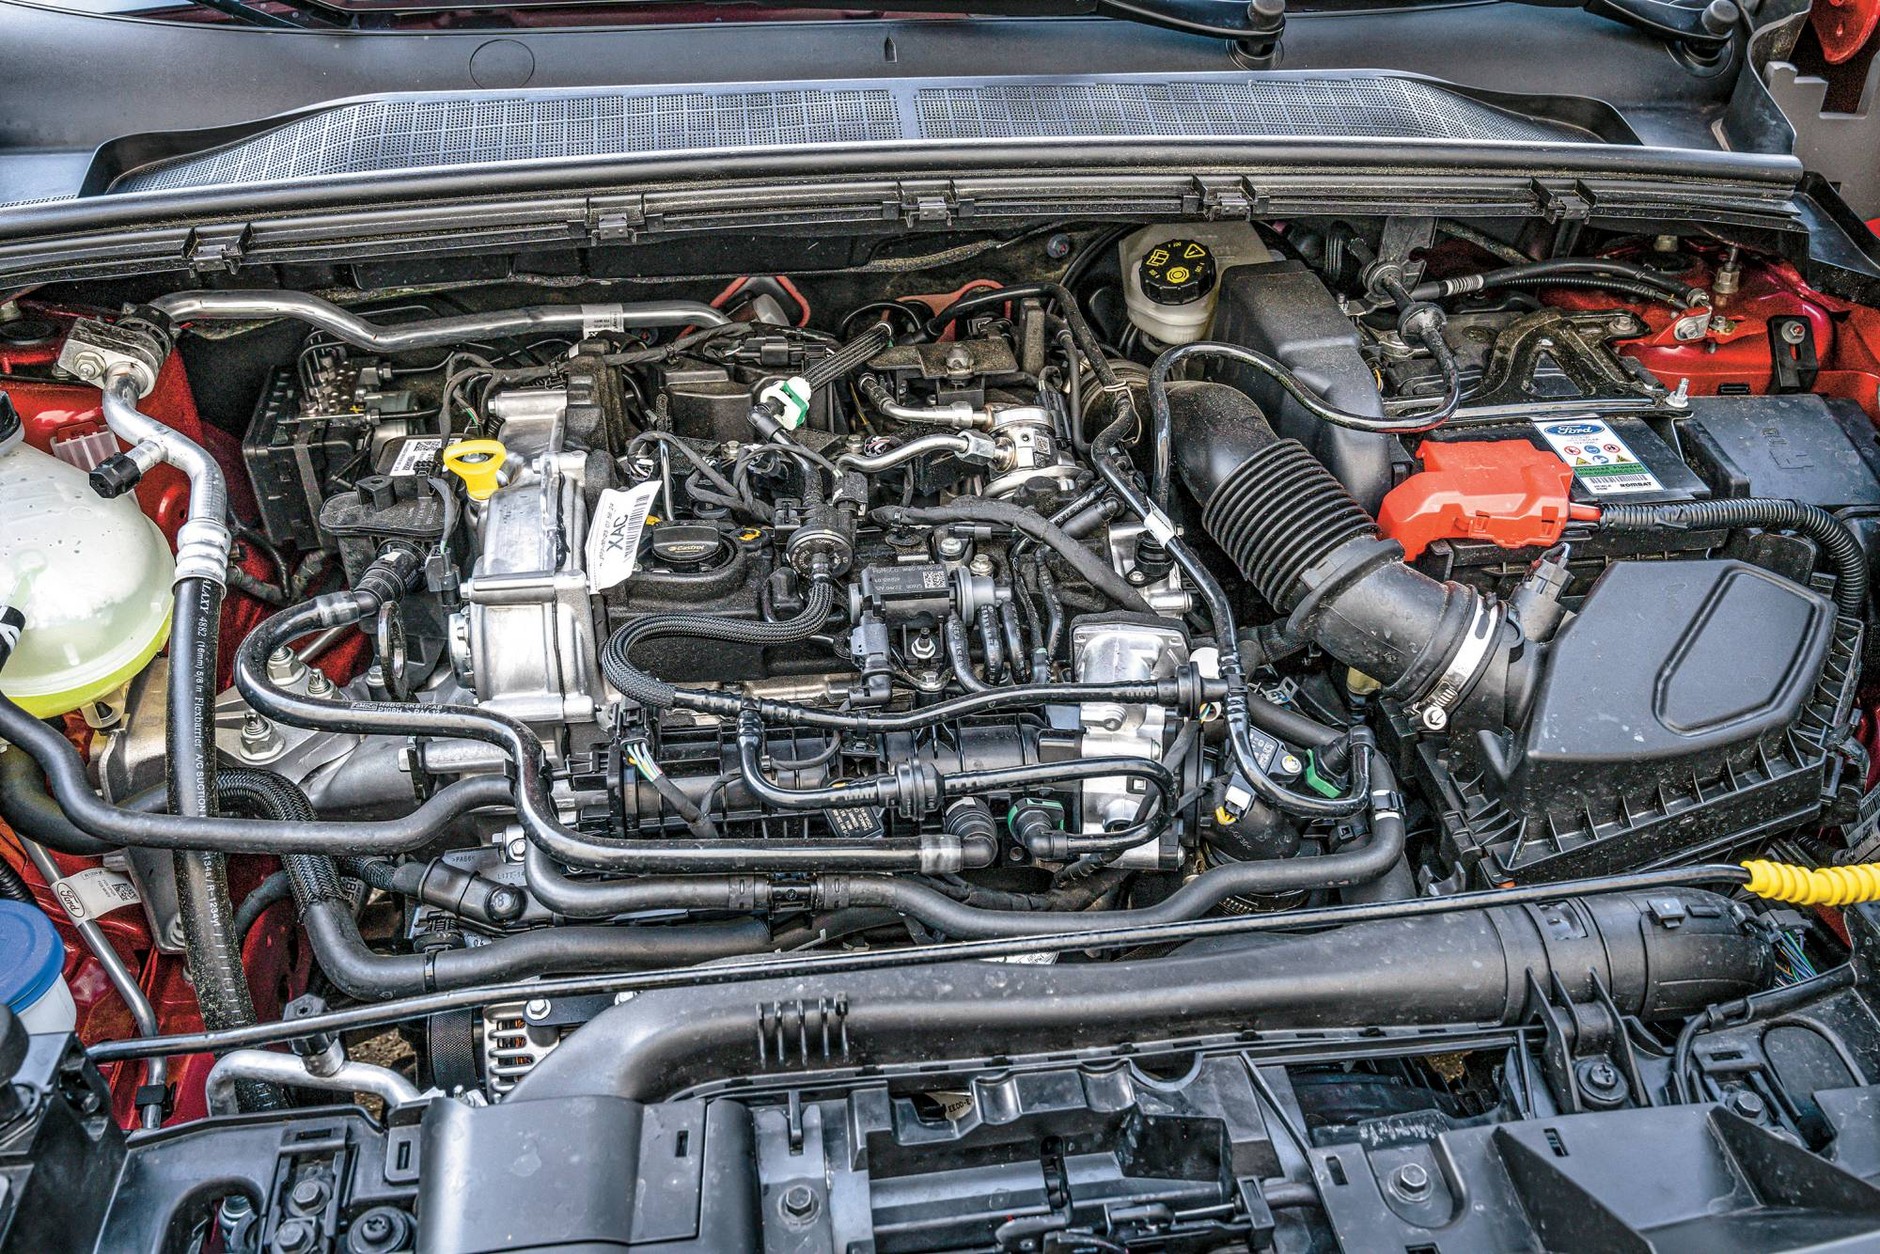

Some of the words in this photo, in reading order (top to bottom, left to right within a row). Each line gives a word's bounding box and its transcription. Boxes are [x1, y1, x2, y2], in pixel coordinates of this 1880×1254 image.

[606, 514, 628, 551] XAC
[200, 578, 212, 614] ALAXY
[198, 616, 208, 637] 4882
[195, 640, 206, 669] (16mm)
[194, 670, 204, 684] 5/8
[194, 696, 204, 748] Flexbarrier
[195, 754, 204, 769] A/C
[196, 771, 206, 812] SUCTION
[203, 851, 213, 877] -134a
